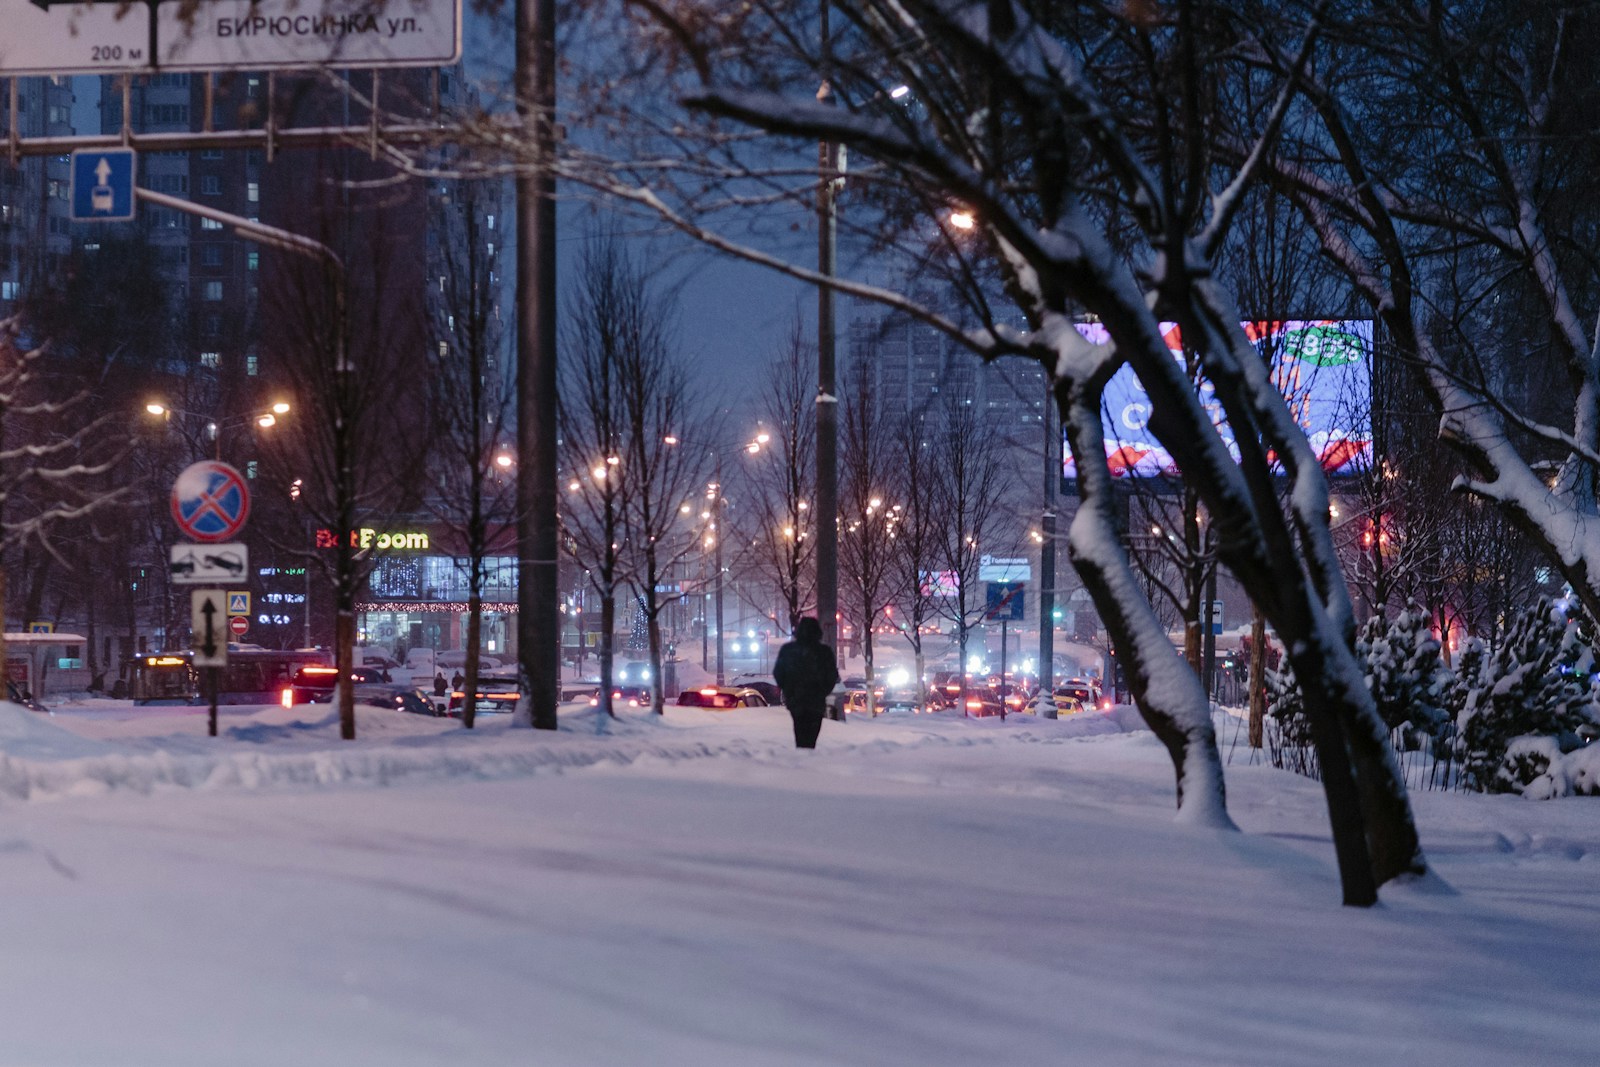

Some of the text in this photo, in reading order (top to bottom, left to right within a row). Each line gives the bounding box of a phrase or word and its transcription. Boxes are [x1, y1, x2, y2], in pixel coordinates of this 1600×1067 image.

[217, 14, 423, 37] БИРЮСИНКА ул.
[91, 46, 142, 61] 200 м
